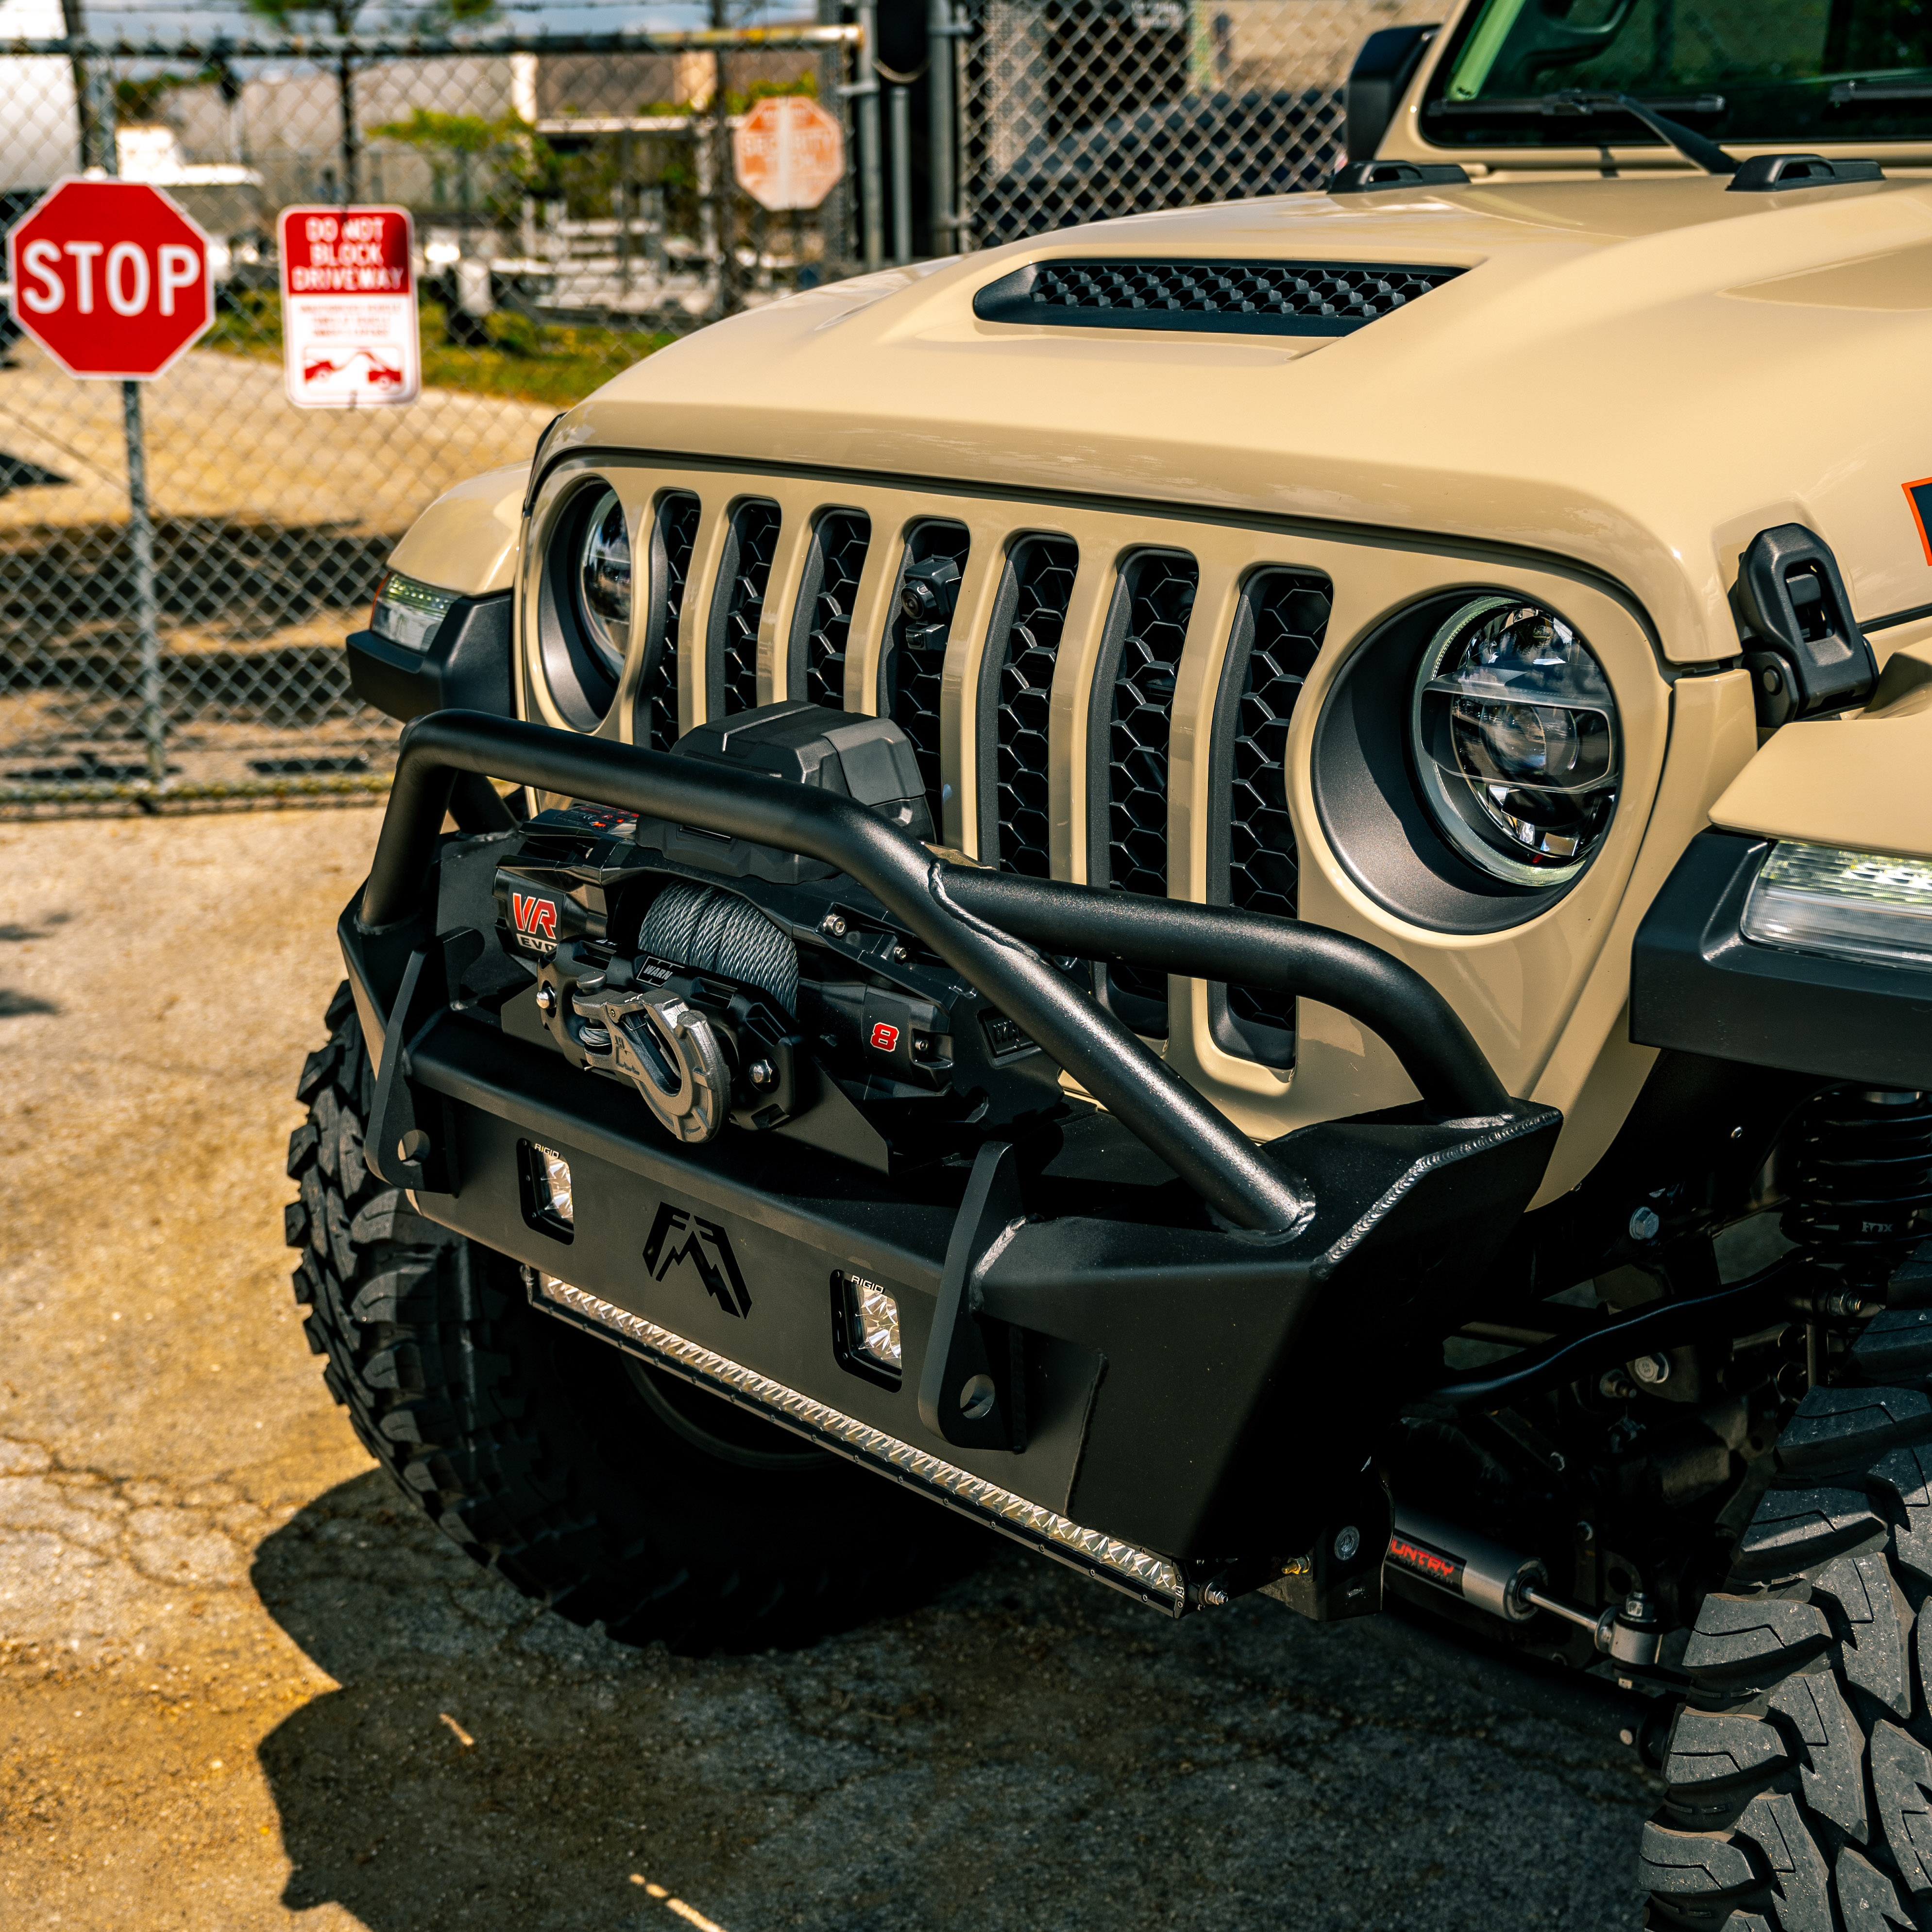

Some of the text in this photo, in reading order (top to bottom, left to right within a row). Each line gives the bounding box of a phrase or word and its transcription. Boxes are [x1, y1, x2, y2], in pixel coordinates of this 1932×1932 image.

[305, 216, 385, 242] DO NOT
[309, 242, 384, 267] BLOCK
[22, 238, 201, 317] STOP
[291, 265, 404, 291] DRIVEWAY
[513, 893, 557, 940] VR
[643, 965, 673, 981] WARN
[870, 1022, 899, 1052] 8
[535, 1143, 559, 1159] RIGID
[1862, 1221, 1893, 1233] FOX
[851, 1275, 884, 1294] RIGID
